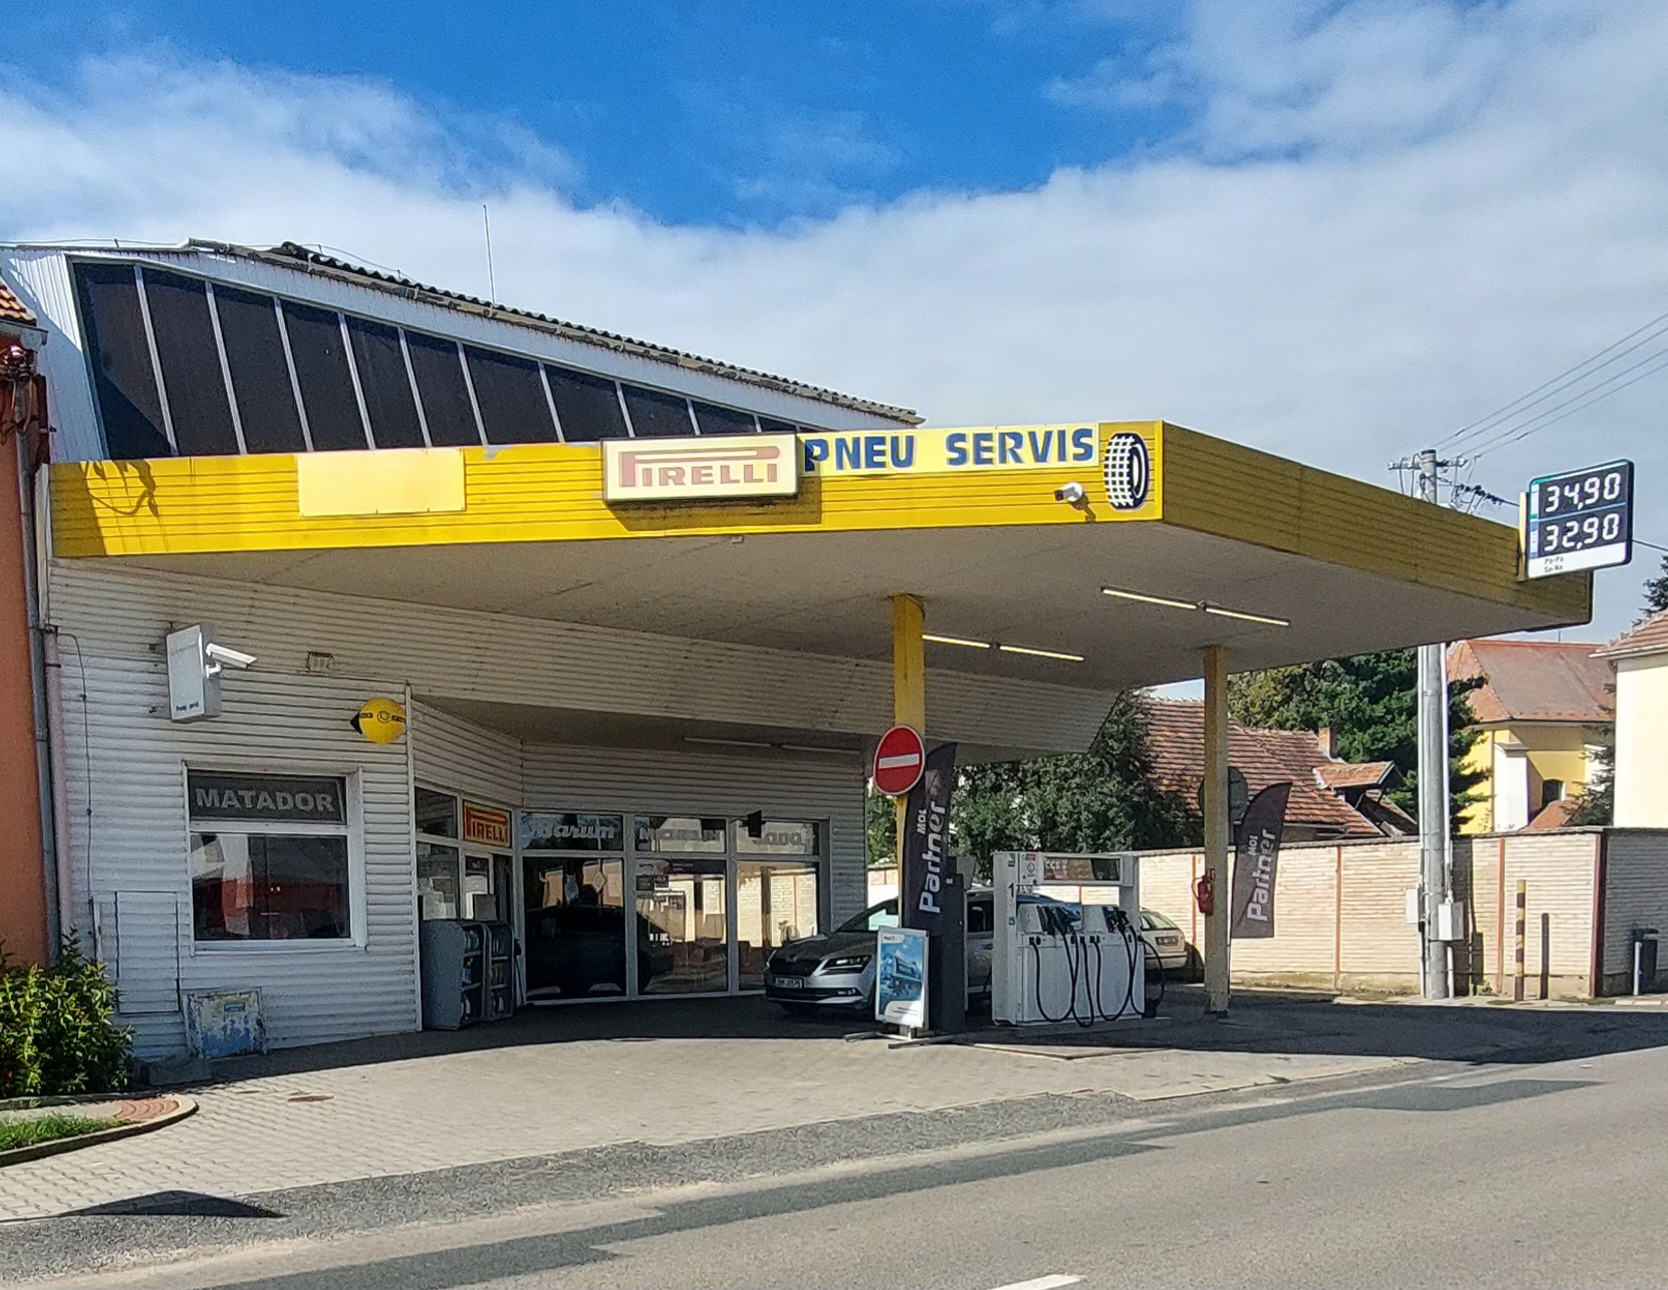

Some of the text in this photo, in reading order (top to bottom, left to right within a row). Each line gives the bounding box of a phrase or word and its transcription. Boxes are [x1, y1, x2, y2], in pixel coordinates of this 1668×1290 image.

[619, 445, 780, 488] PIRELLI
[804, 428, 1094, 472] PNEU SERVIS
[1545, 472, 1621, 513] 34,90
[1544, 513, 1620, 552] 32,90
[195, 788, 335, 813] MATADOR
[465, 805, 509, 843] PIRELLI
[917, 808, 928, 836] MOL
[919, 800, 946, 914] Partner
[1247, 835, 1258, 857] MOL
[1008, 882, 1015, 899] 1
[1246, 828, 1276, 922] Partner
